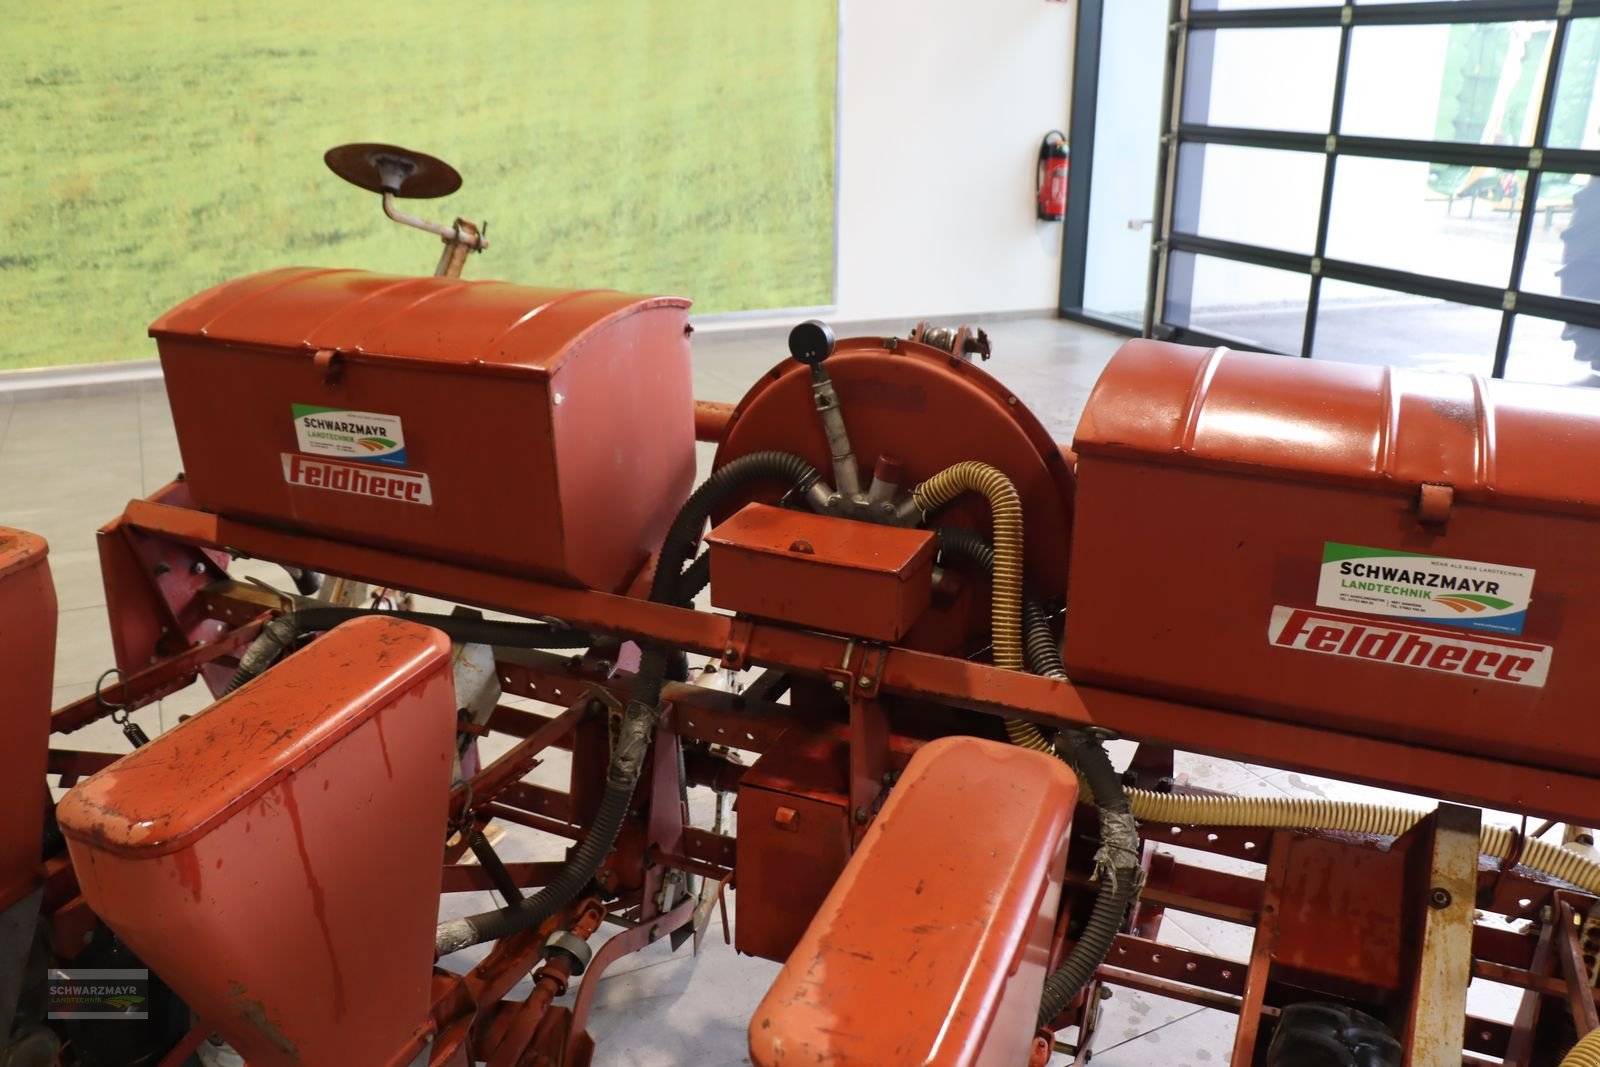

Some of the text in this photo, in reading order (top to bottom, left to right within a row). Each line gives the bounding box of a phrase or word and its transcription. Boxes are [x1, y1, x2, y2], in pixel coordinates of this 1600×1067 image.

[303, 417, 388, 437] SCHWARZMAYR
[307, 430, 356, 443] LANDTECHNIK
[289, 455, 424, 503] Feldherr
[1340, 561, 1500, 595] SCHWARZMAYR
[1340, 578, 1433, 600] LANDTECHNIK
[1275, 609, 1545, 682] Feldherr
